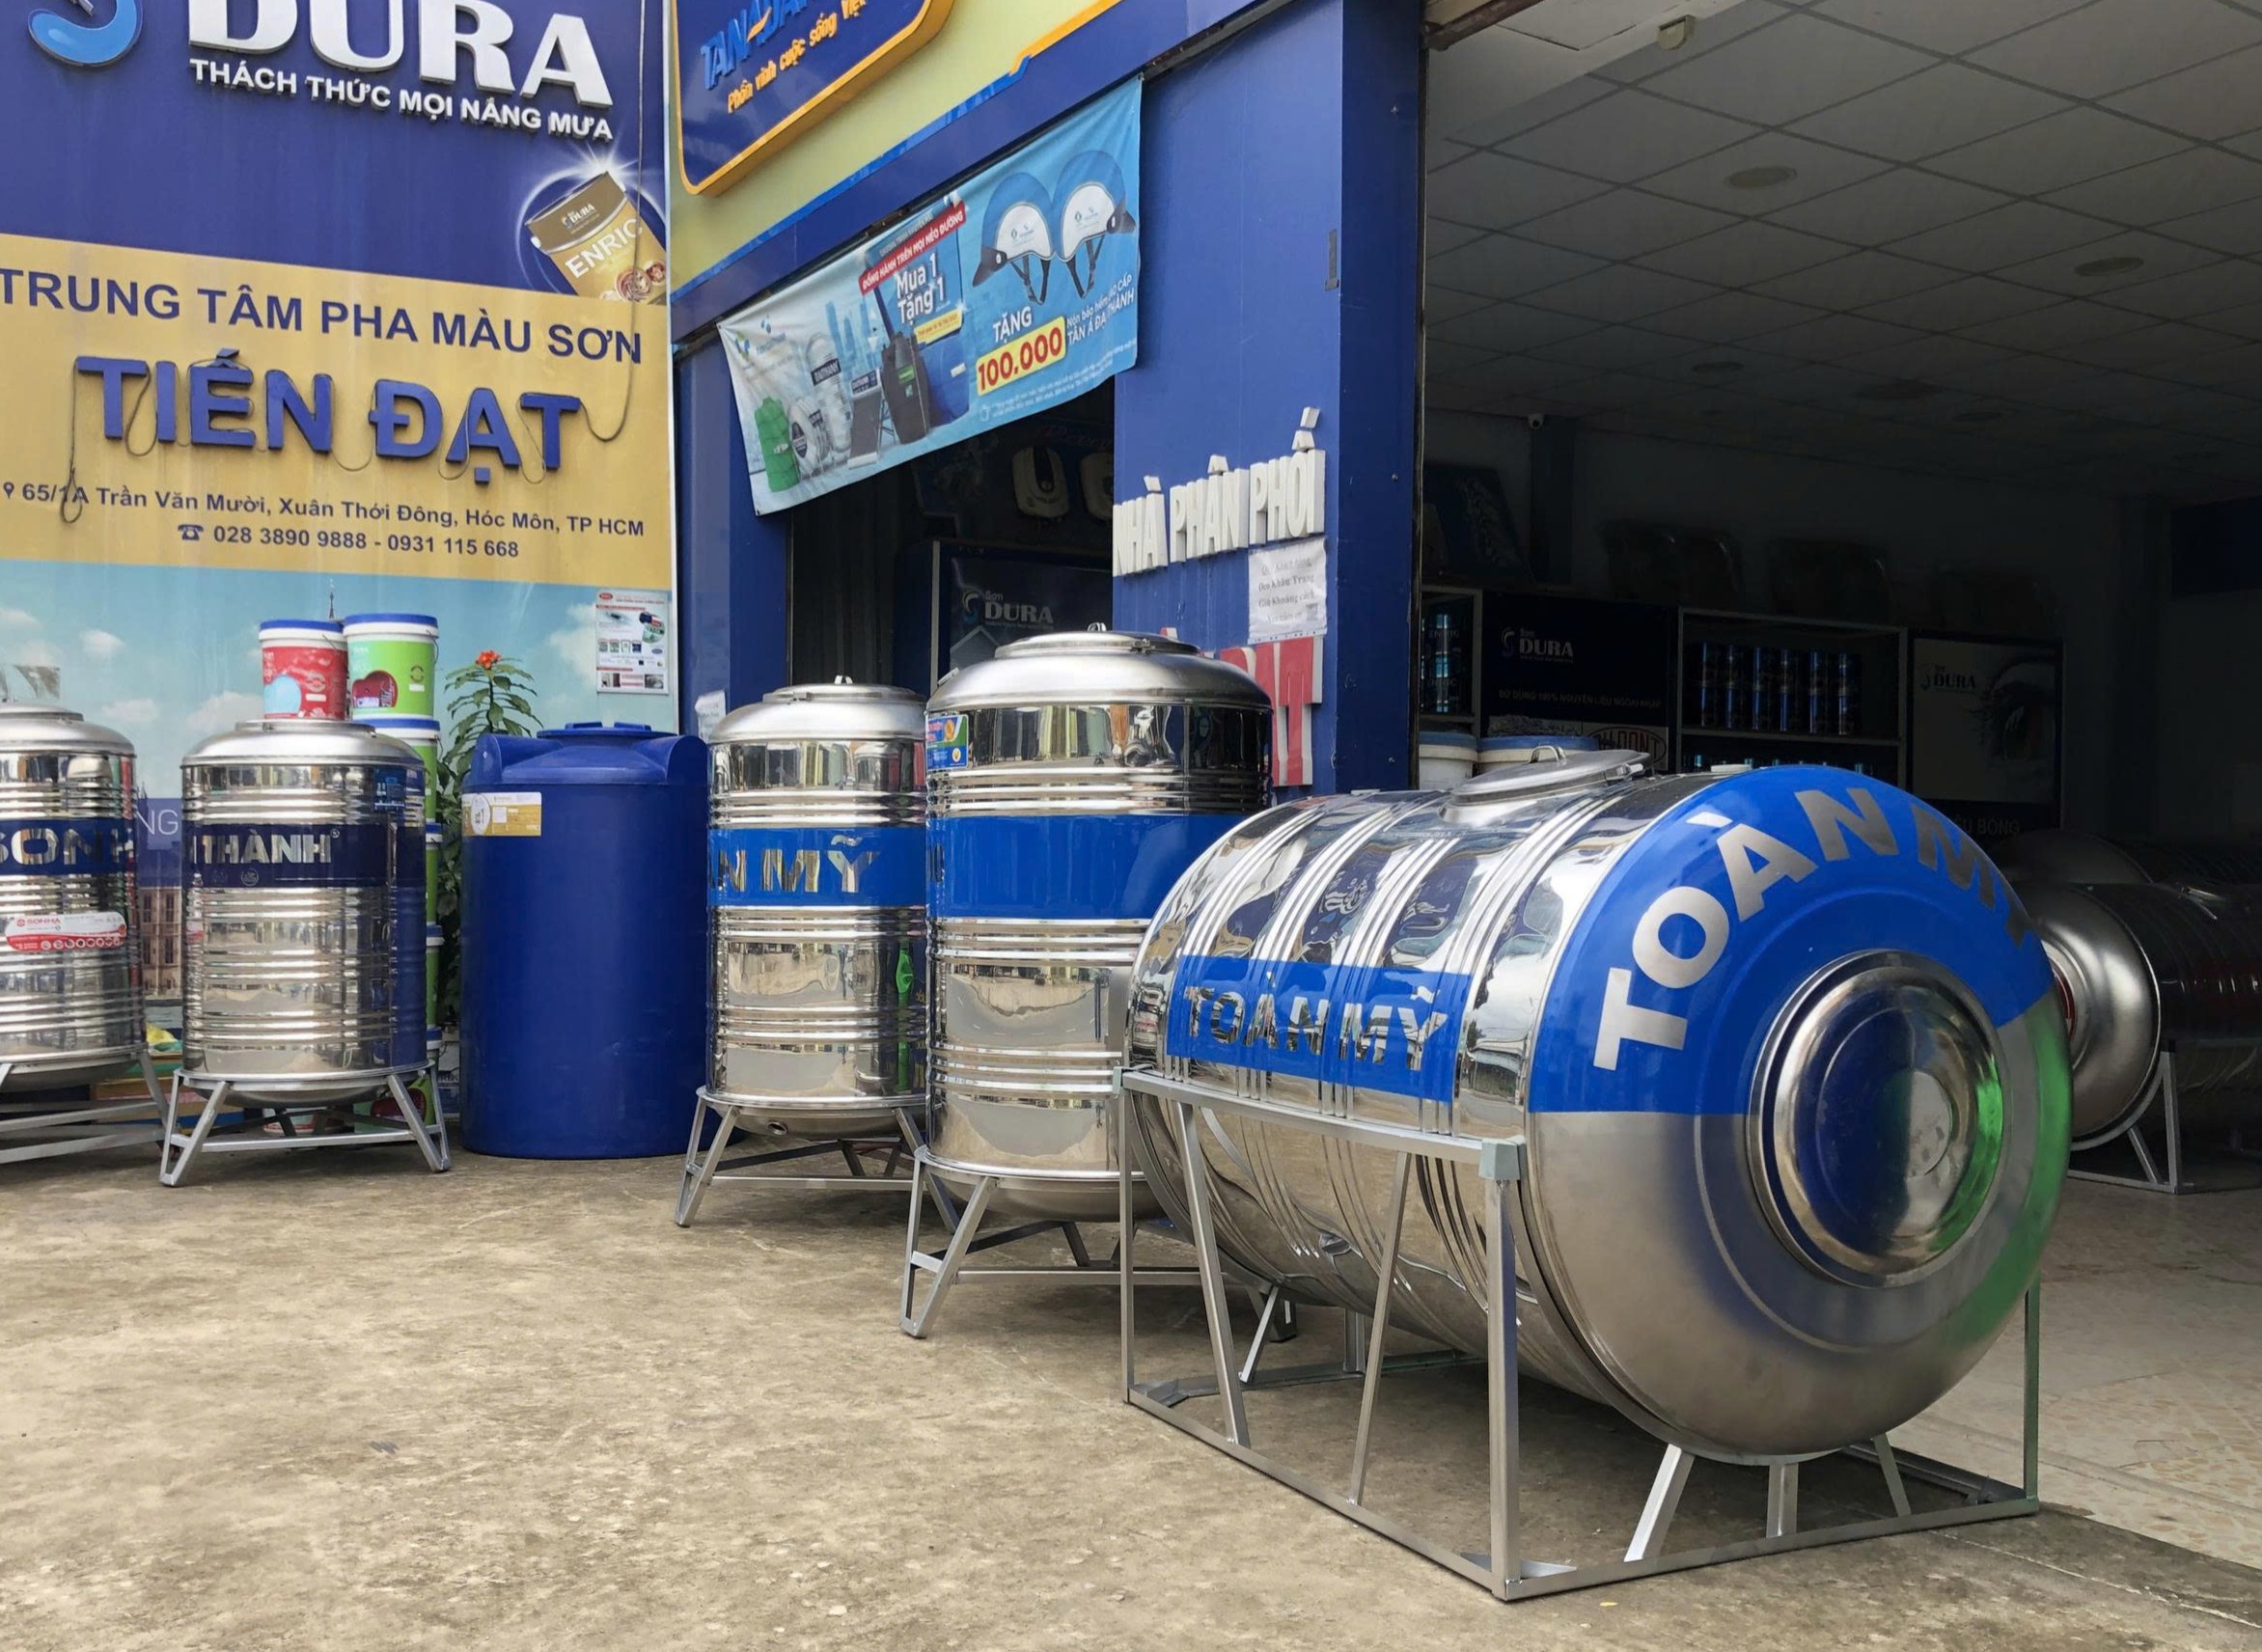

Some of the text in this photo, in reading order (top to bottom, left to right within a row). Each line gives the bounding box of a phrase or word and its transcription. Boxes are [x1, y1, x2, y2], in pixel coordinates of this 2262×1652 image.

[189, 0, 613, 107] DURA
[189, 58, 297, 95] THÁCH
[305, 75, 391, 109] THỨC
[400, 89, 454, 121] MỌI
[549, 111, 614, 141] MƯA
[565, 218, 644, 279] ENRIC
[897, 253, 937, 299] Mua 1
[0, 267, 641, 364] TRUNG TÂM PHA MÀU SƠN
[897, 288, 934, 326] Tặng
[937, 276, 945, 301] 1
[992, 305, 1033, 344] TẶNG
[978, 326, 1062, 392] 100.000
[1067, 324, 1086, 345] TÂN
[76, 348, 581, 484] TIẾN ĐẠT
[97, 484, 148, 508] Trần
[154, 490, 198, 510] Văn
[207, 493, 272, 516] Mười,
[279, 496, 335, 517] Xuân
[341, 501, 390, 522] Thới
[397, 505, 458, 529] Đông,
[466, 509, 505, 528] Hóc
[511, 512, 561, 533] Môn,
[566, 516, 593, 533] TP
[599, 518, 645, 537] HCM
[1112, 406, 1326, 577] NHÀ PHÂN PHỐI
[213, 525, 252, 544] 028
[260, 527, 311, 546] 3890
[317, 530, 367, 549] 9888
[387, 535, 435, 553] 0931
[443, 537, 479, 556] 115
[483, 540, 519, 558] 668
[984, 601, 1054, 624] DURA
[1519, 638, 1575, 657] DURA
[1934, 674, 1976, 689] DURA
[201, 829, 332, 865] THÀNH
[761, 834, 881, 894] MỸ
[1593, 787, 1898, 1072] TOÀN
[1183, 971, 1448, 1071] TOÀN MỸ
